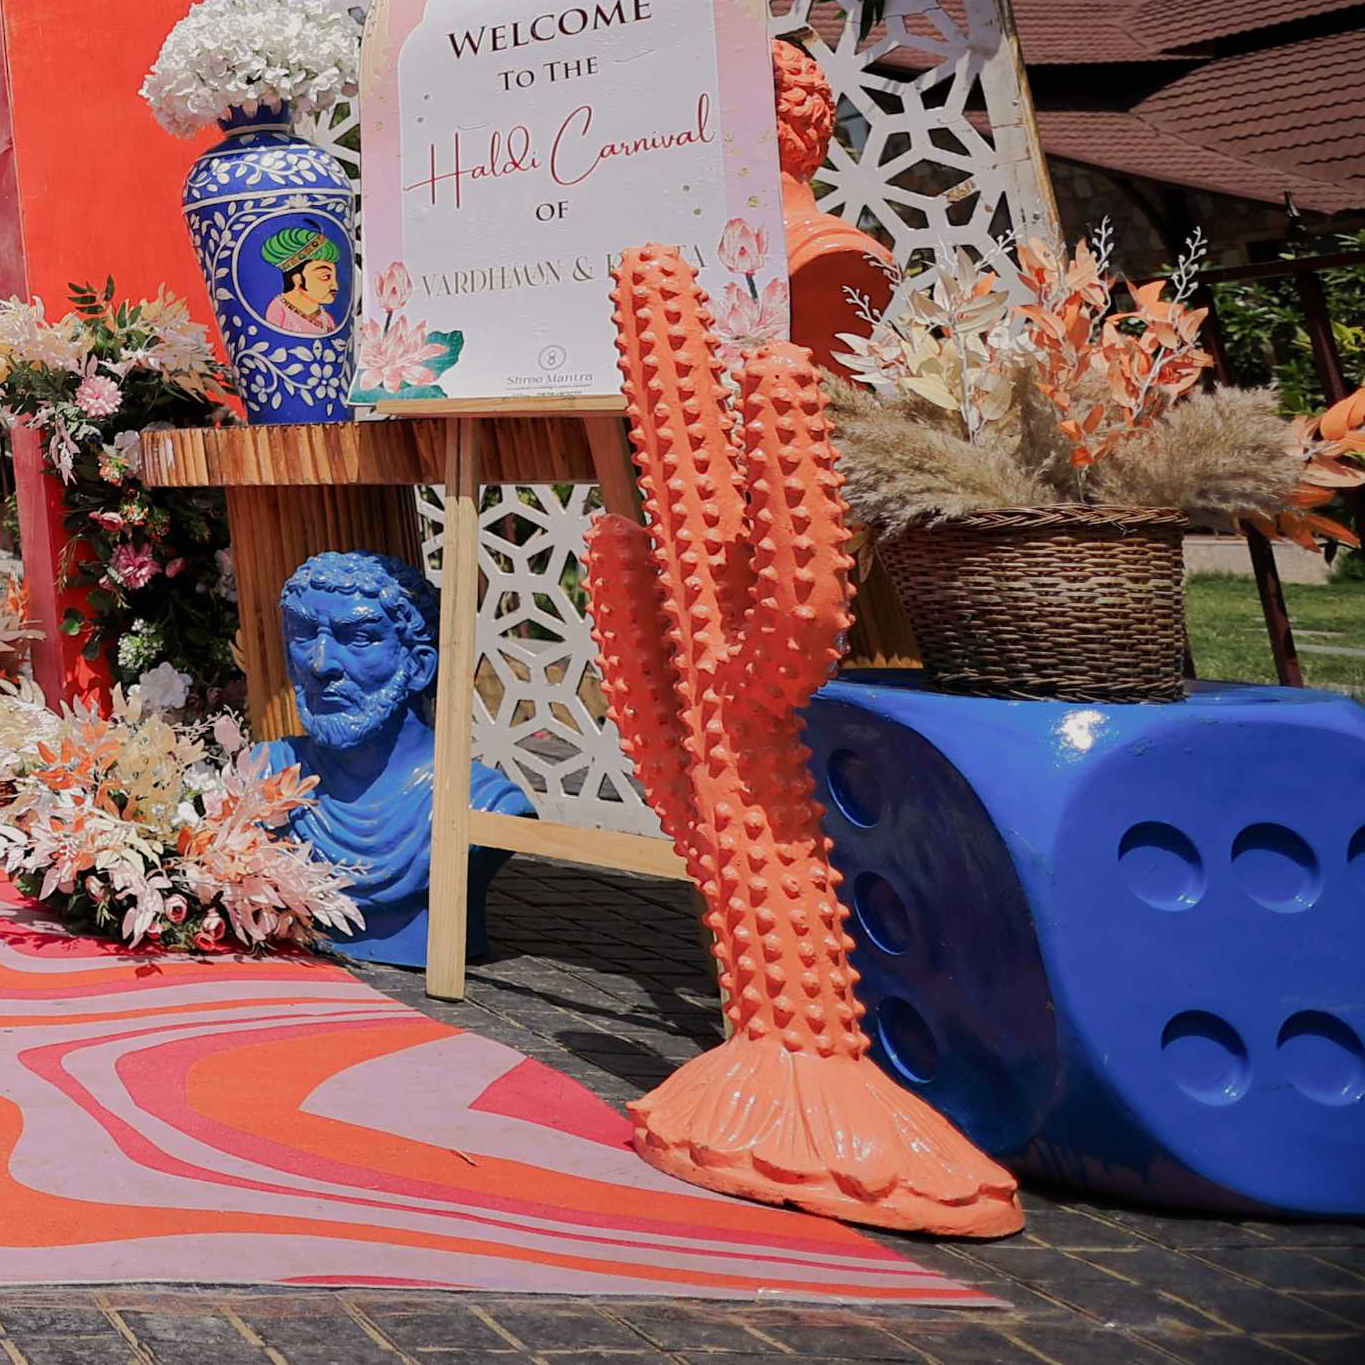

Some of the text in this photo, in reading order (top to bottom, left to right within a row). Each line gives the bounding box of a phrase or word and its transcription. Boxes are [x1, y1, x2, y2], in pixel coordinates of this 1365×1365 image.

[498, 56, 599, 91] TO THE
[402, 93, 715, 208] Haldi Carnival
[536, 201, 569, 221] OF
[572, 255, 594, 282] &
